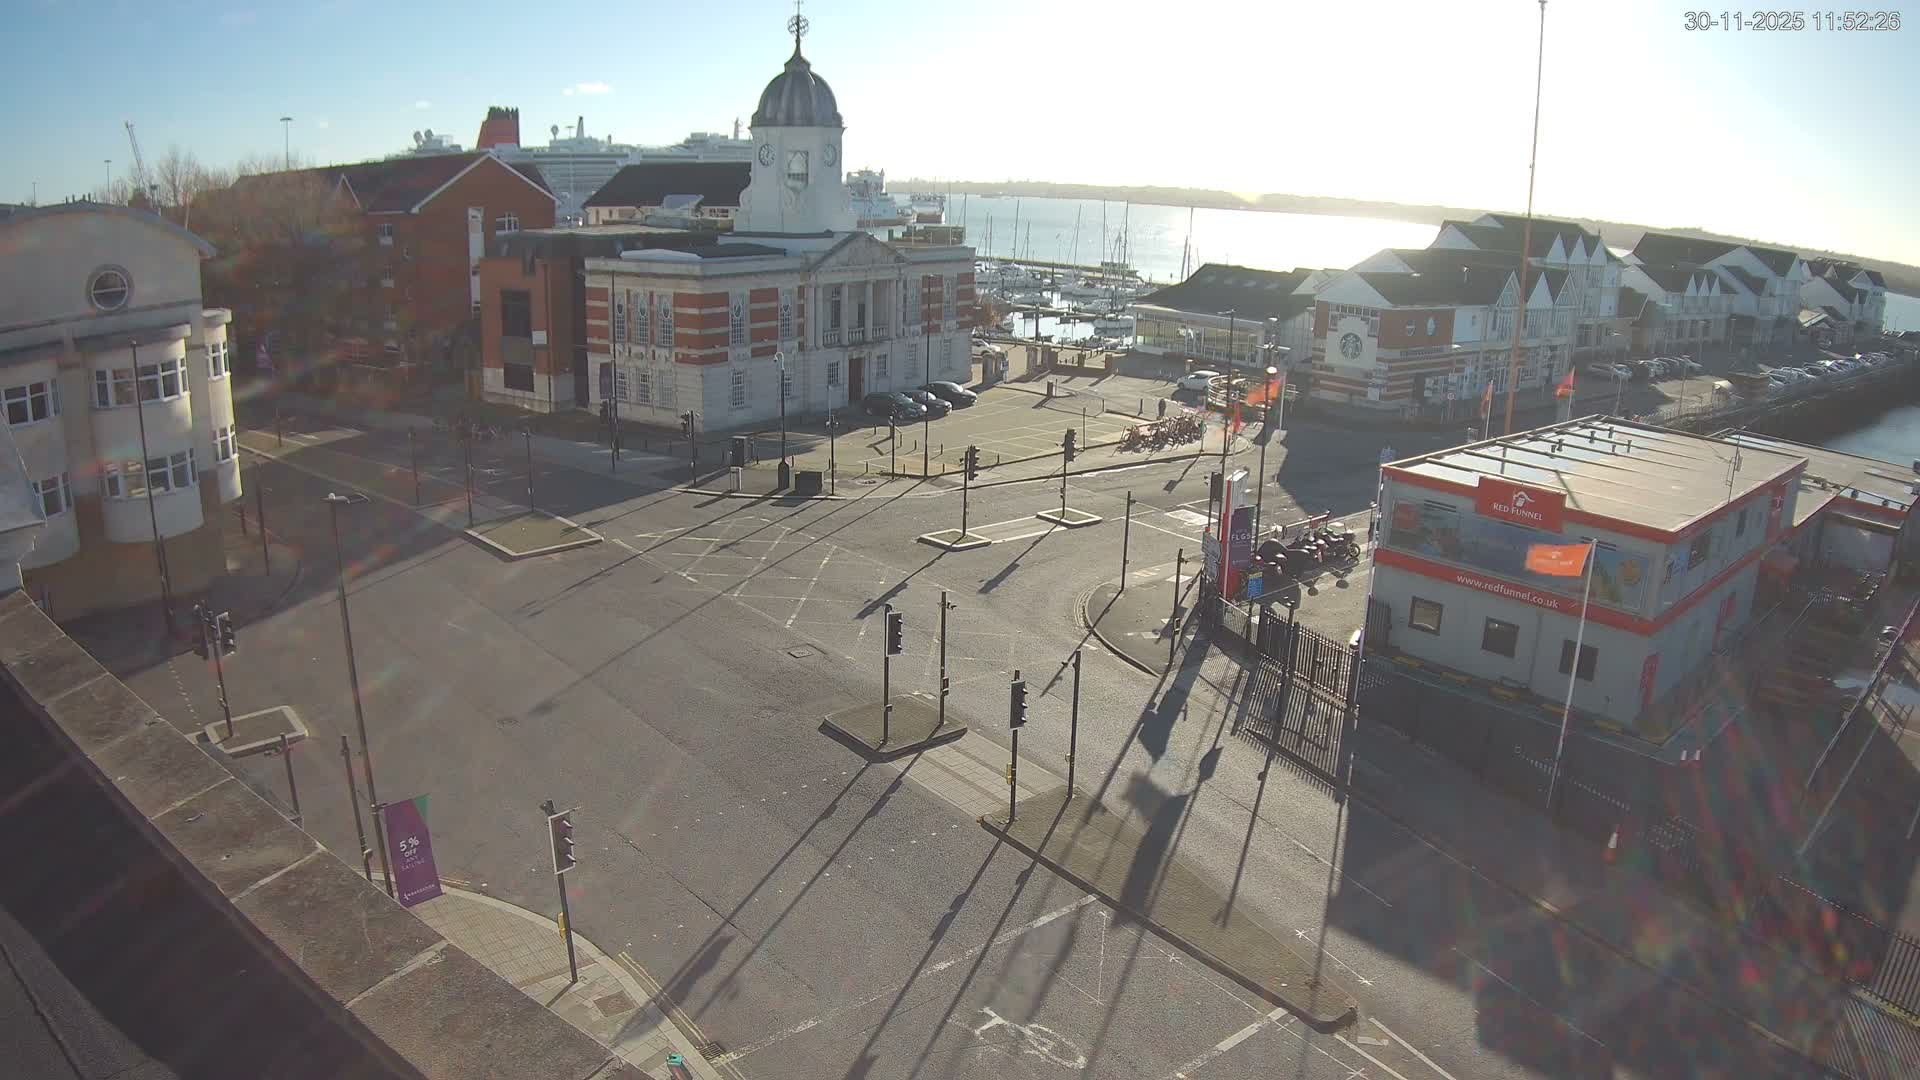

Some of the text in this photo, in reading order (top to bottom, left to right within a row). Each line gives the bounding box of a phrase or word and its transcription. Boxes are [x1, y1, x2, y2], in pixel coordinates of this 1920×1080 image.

[1493, 502, 1543, 521] RED FUNNEL
[1457, 575, 1559, 609] www.redfunnel.co.uk
[404, 848, 417, 857] OFF
